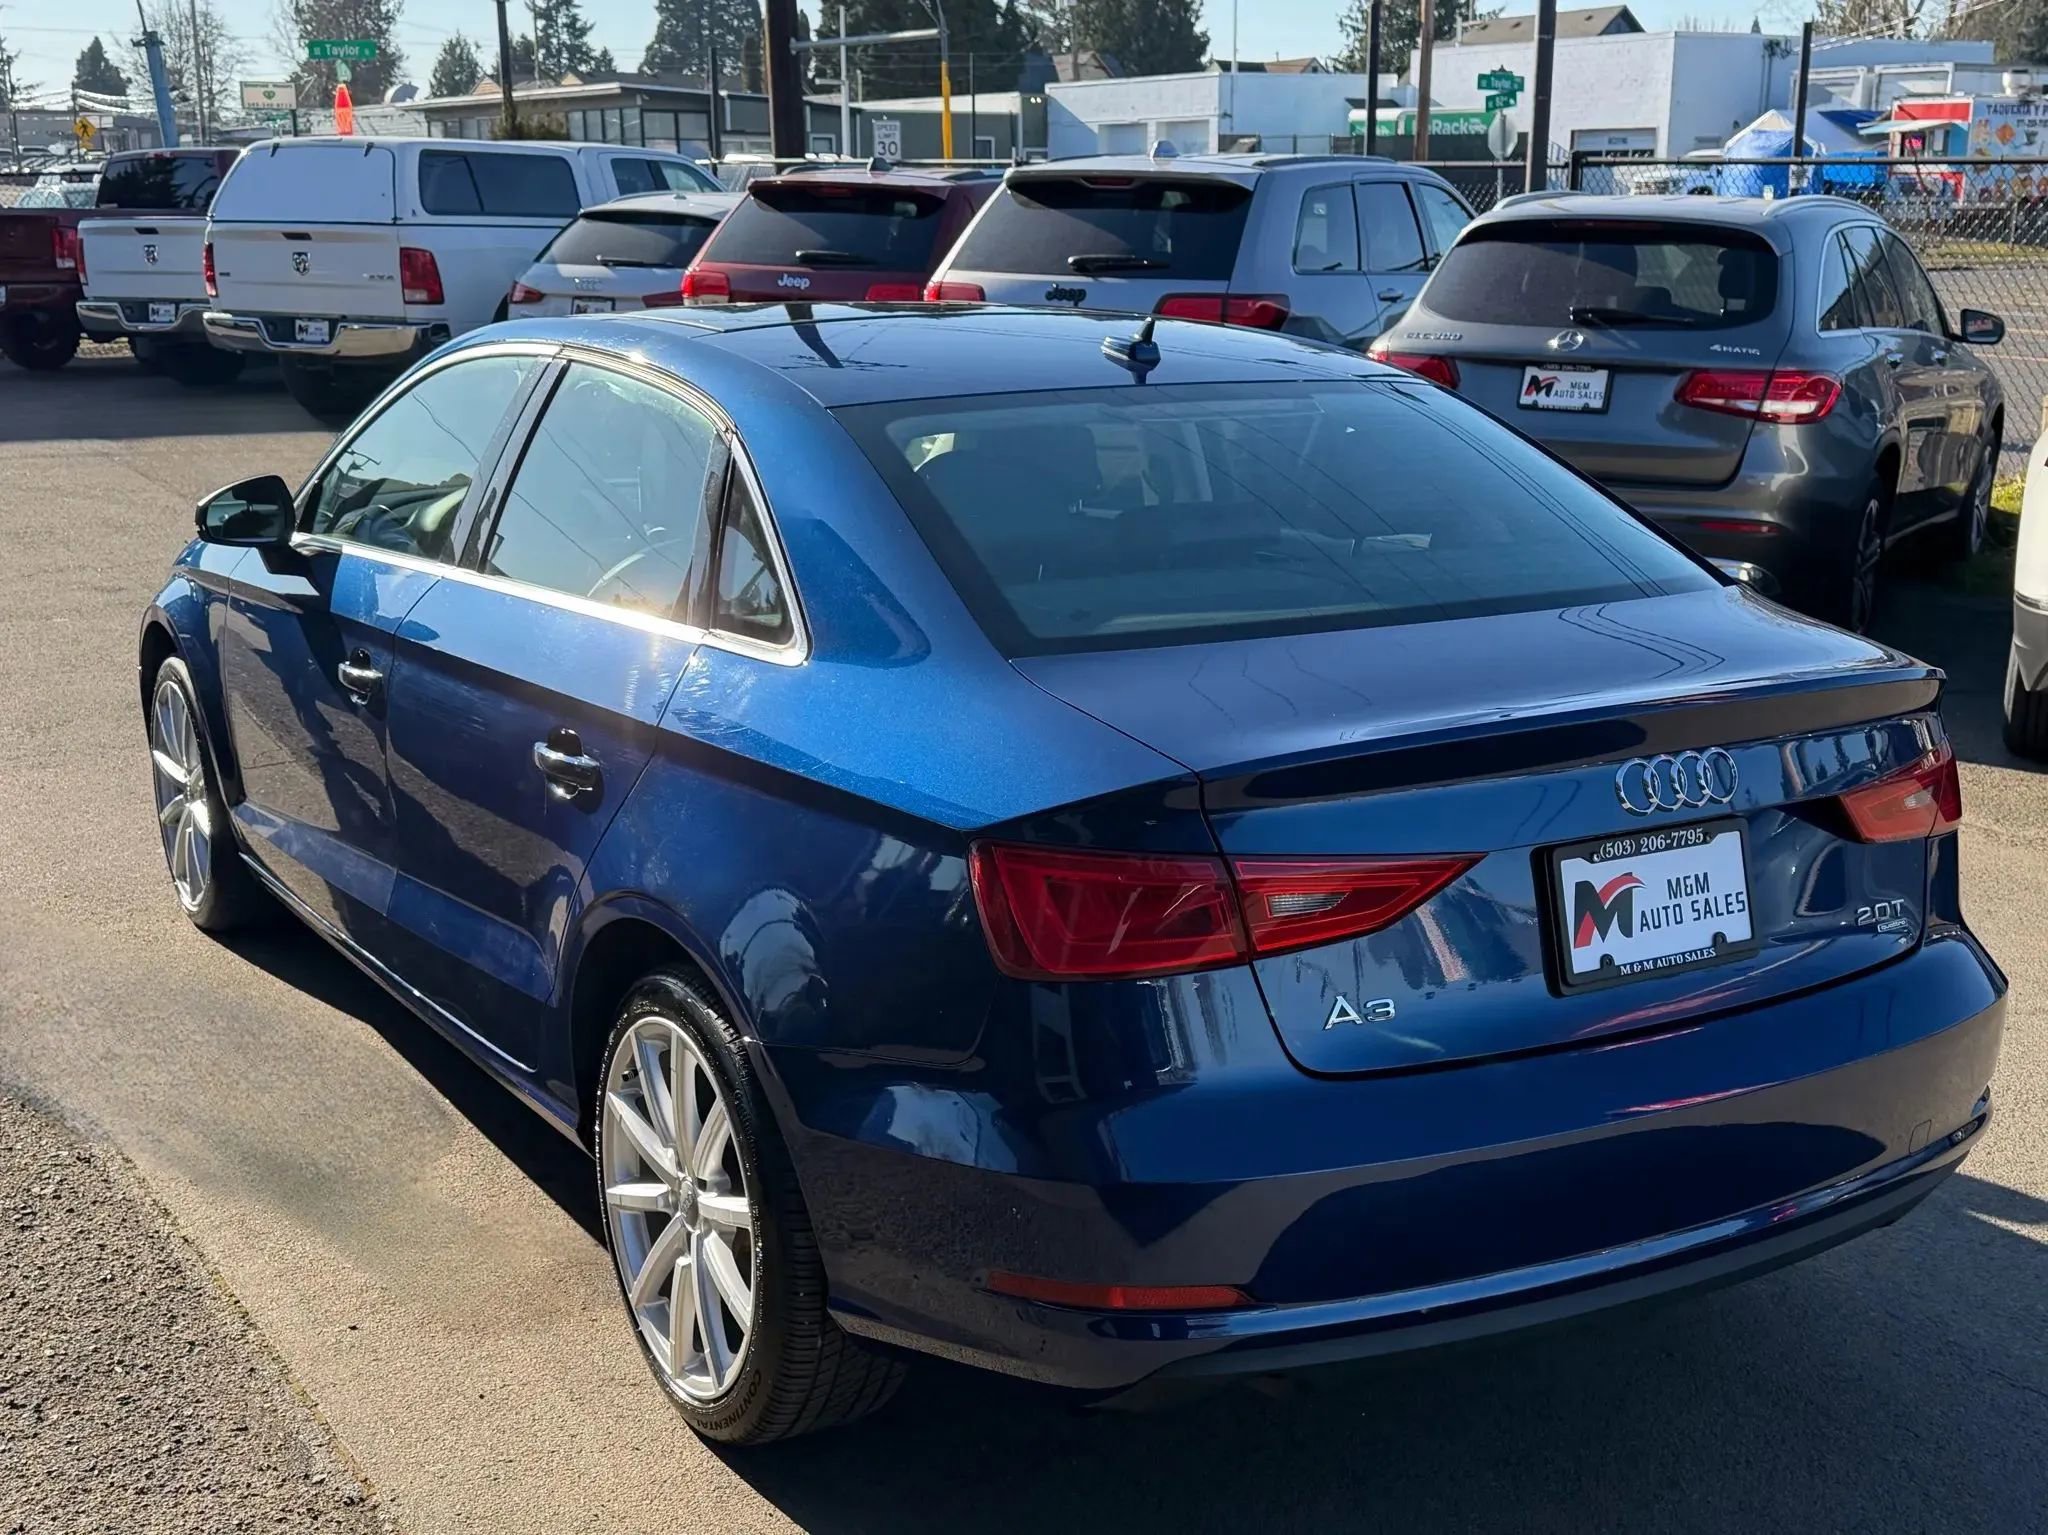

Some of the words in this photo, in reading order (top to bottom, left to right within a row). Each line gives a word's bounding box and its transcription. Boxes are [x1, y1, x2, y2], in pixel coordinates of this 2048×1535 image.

[325, 43, 360, 57] Taylor
[1986, 104, 2032, 116] TAQUERIA
[877, 140, 898, 156] 30
[777, 273, 811, 290] Jeep
[1044, 282, 1087, 307] Jeep
[1709, 344, 1760, 356] 4MATIC
[1569, 381, 1592, 390] M&M
[1552, 389, 1576, 399] AUTO
[1577, 390, 1604, 401] SALES
[1600, 838, 1636, 859] (503)
[1640, 828, 1704, 851] 206-7795
[1666, 871, 1711, 901] M&M
[1639, 902, 1684, 933] AUTO
[1691, 891, 1747, 922] SALES
[1620, 964, 1632, 976] M
[1633, 962, 1642, 973] &
[1643, 959, 1655, 971] M
[1656, 954, 1685, 969] AUTO
[1685, 947, 1717, 962] SALES
[1324, 995, 1396, 1030] A3
